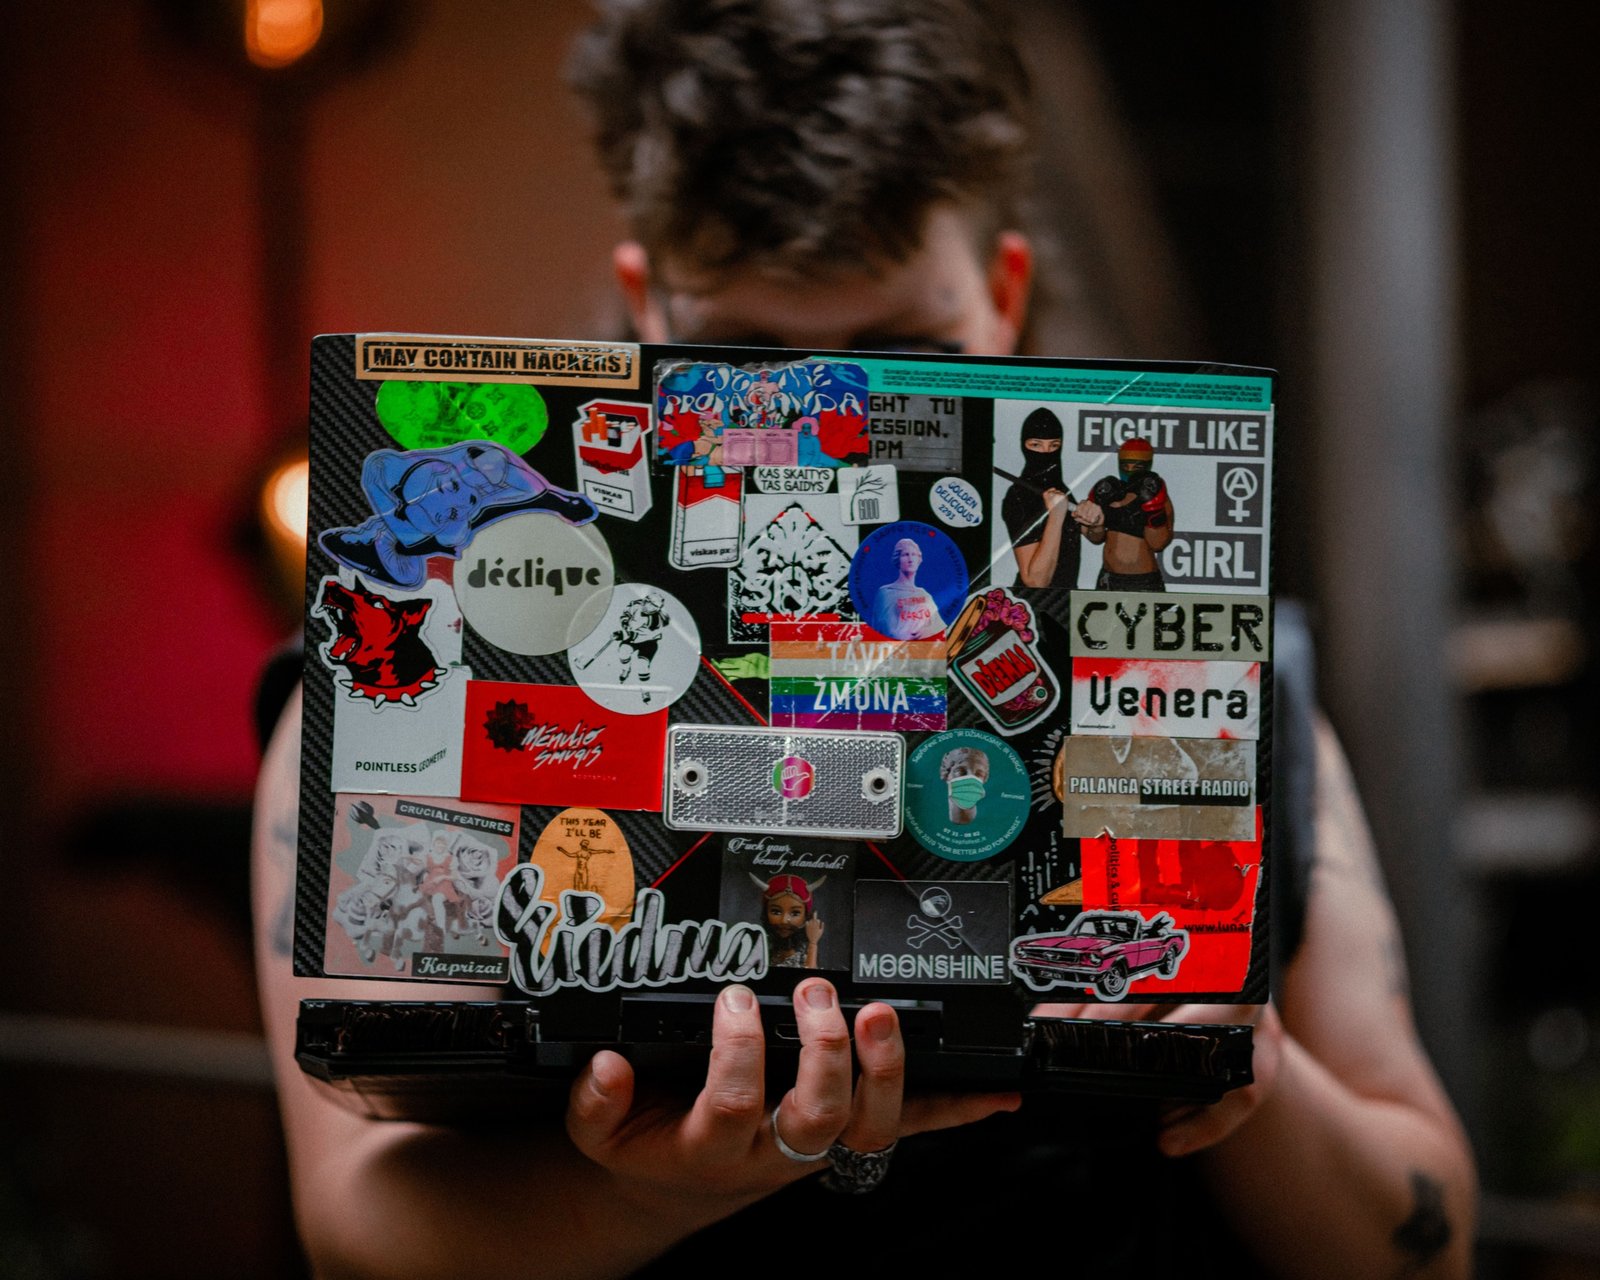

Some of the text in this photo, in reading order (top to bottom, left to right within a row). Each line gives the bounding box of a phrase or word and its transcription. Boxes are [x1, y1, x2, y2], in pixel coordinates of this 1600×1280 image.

[373, 349, 621, 373] MAY CONTAIN HACKERS
[706, 366, 749, 391] WE
[869, 395, 955, 414] GHT TO
[870, 417, 949, 438] ESSION.
[1083, 416, 1260, 451] FIGHT LIKE
[758, 466, 831, 480] KAS SKAITYS
[761, 480, 824, 492] TAS GAIDYS
[948, 481, 978, 509] GOLDEN
[935, 485, 974, 522] DELICIOUS
[1161, 537, 1256, 580] GIRL
[467, 557, 601, 596] déclique
[1077, 601, 1264, 653] CYBER
[813, 674, 910, 711] ŽMONA
[1090, 675, 1249, 720] Venera
[355, 761, 417, 773] POINTLESS
[1069, 777, 1250, 797] PALANGA STREET RADIO
[400, 804, 512, 833] CRUCIAL FEATURES
[560, 817, 607, 828] THIS YEAR
[589, 829, 602, 839] BE
[727, 836, 774, 854] Fuck
[753, 851, 849, 874] beauty standards!
[417, 956, 503, 976] Kaprizai
[858, 953, 1005, 980] MOONSHINE
